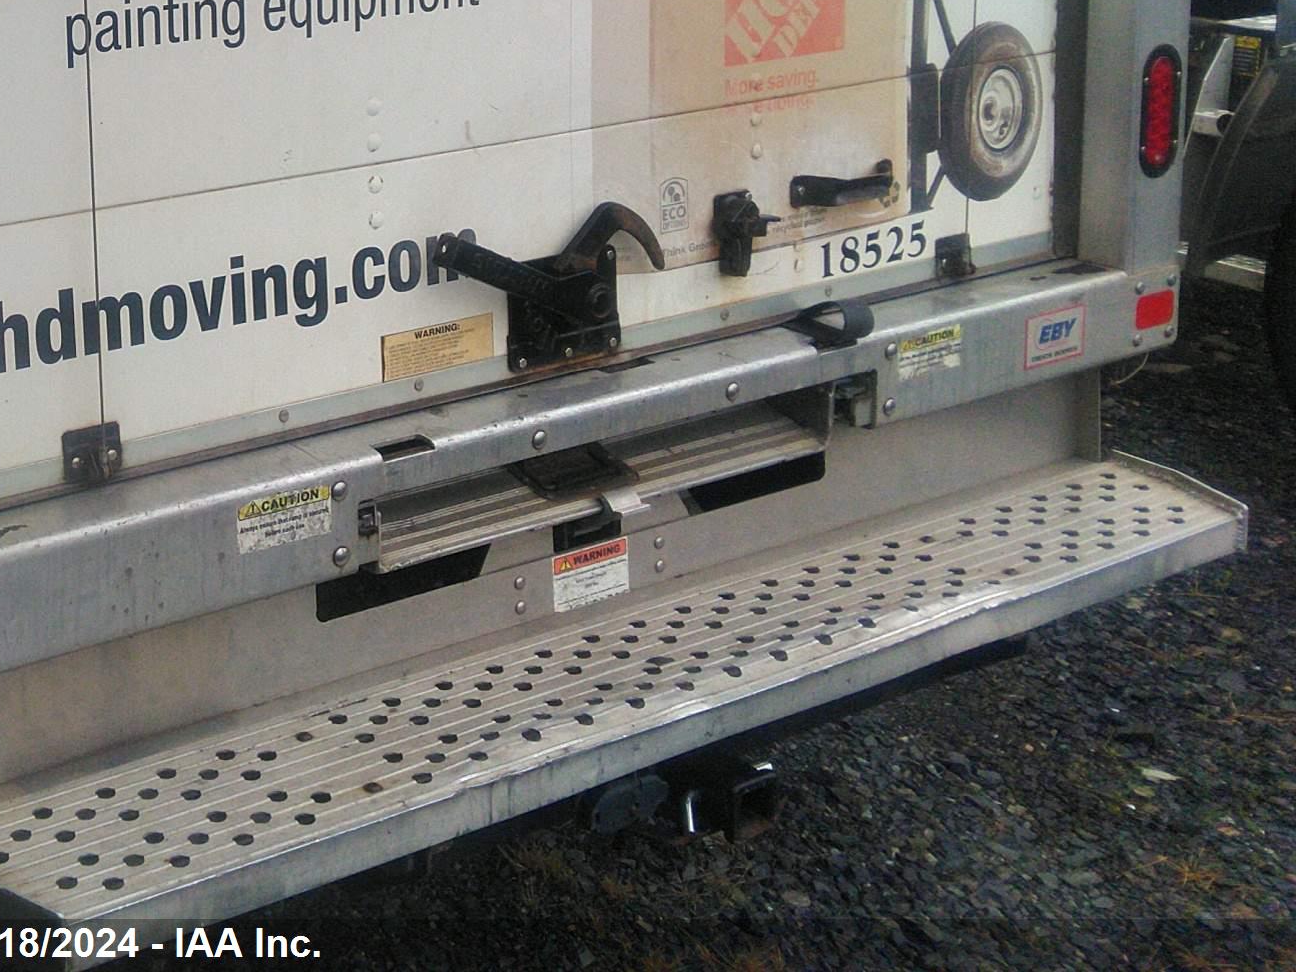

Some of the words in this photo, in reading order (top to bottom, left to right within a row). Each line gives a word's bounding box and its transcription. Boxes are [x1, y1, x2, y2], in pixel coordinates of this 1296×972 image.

[661, 205, 687, 222] ECO
[820, 219, 928, 280] 18525
[1039, 317, 1077, 345] EBY
[261, 488, 319, 512] CAUTION
[573, 544, 621, 566] WARNING
